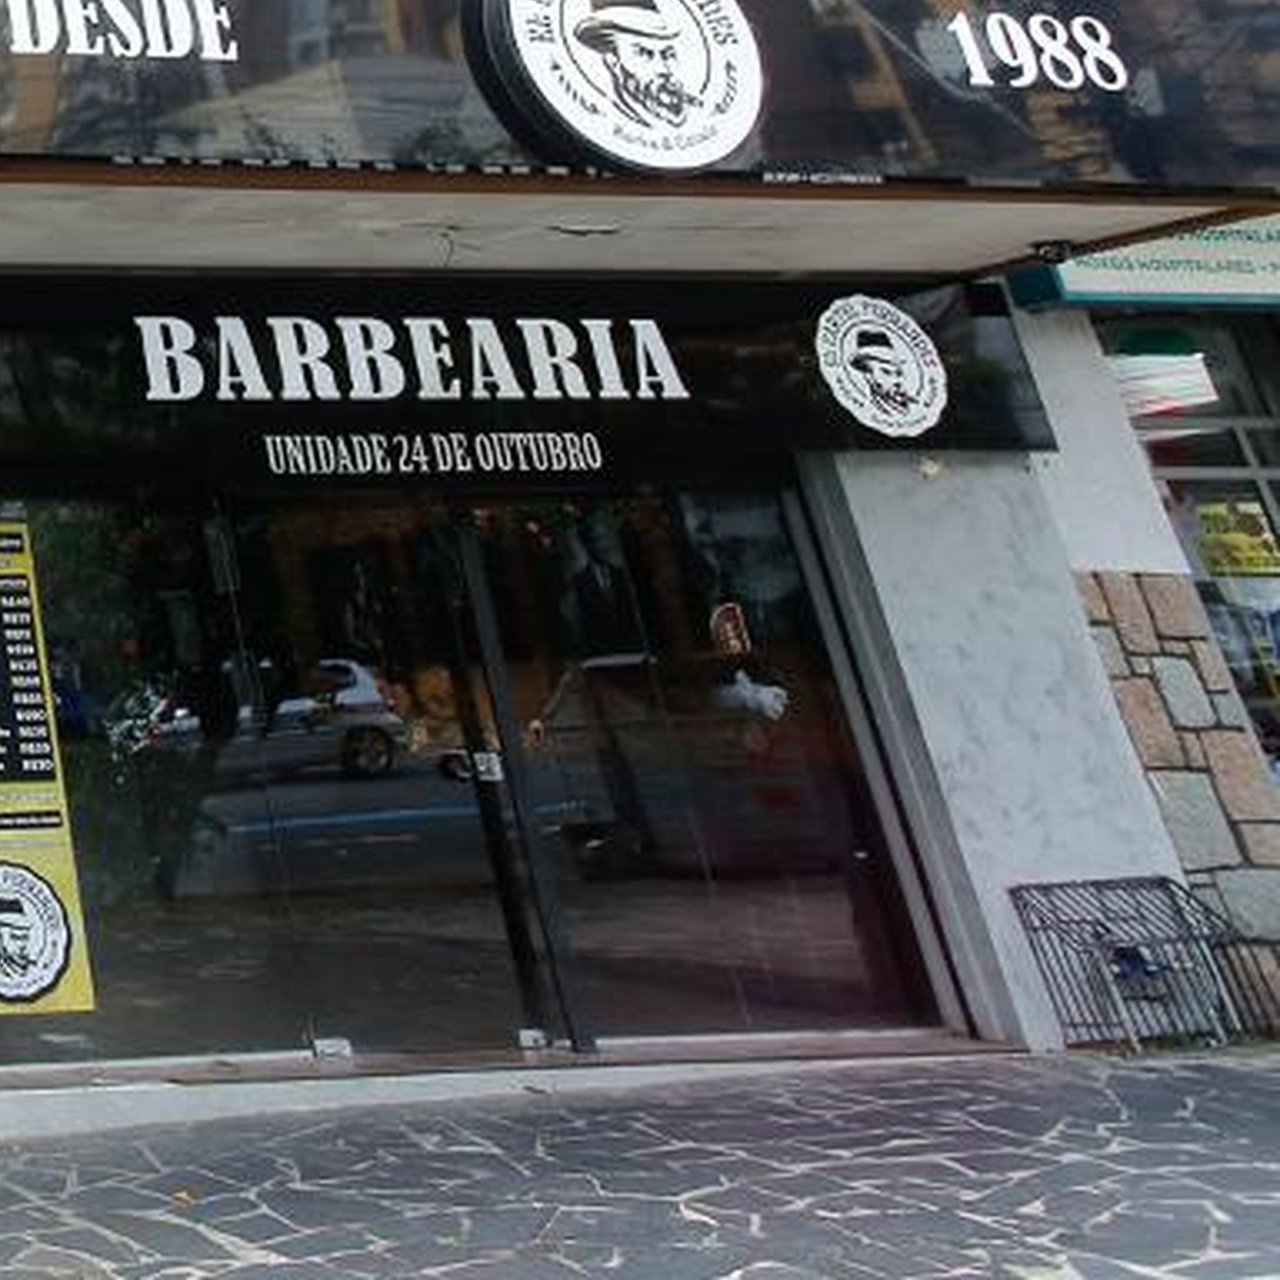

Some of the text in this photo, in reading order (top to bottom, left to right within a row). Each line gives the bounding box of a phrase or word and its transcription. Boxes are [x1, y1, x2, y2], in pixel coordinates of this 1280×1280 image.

[946, 11, 1128, 91] 1988
[133, 316, 691, 401] BARBEARIA
[264, 432, 603, 474] UNIDADE 24 DE OUTUBRO
